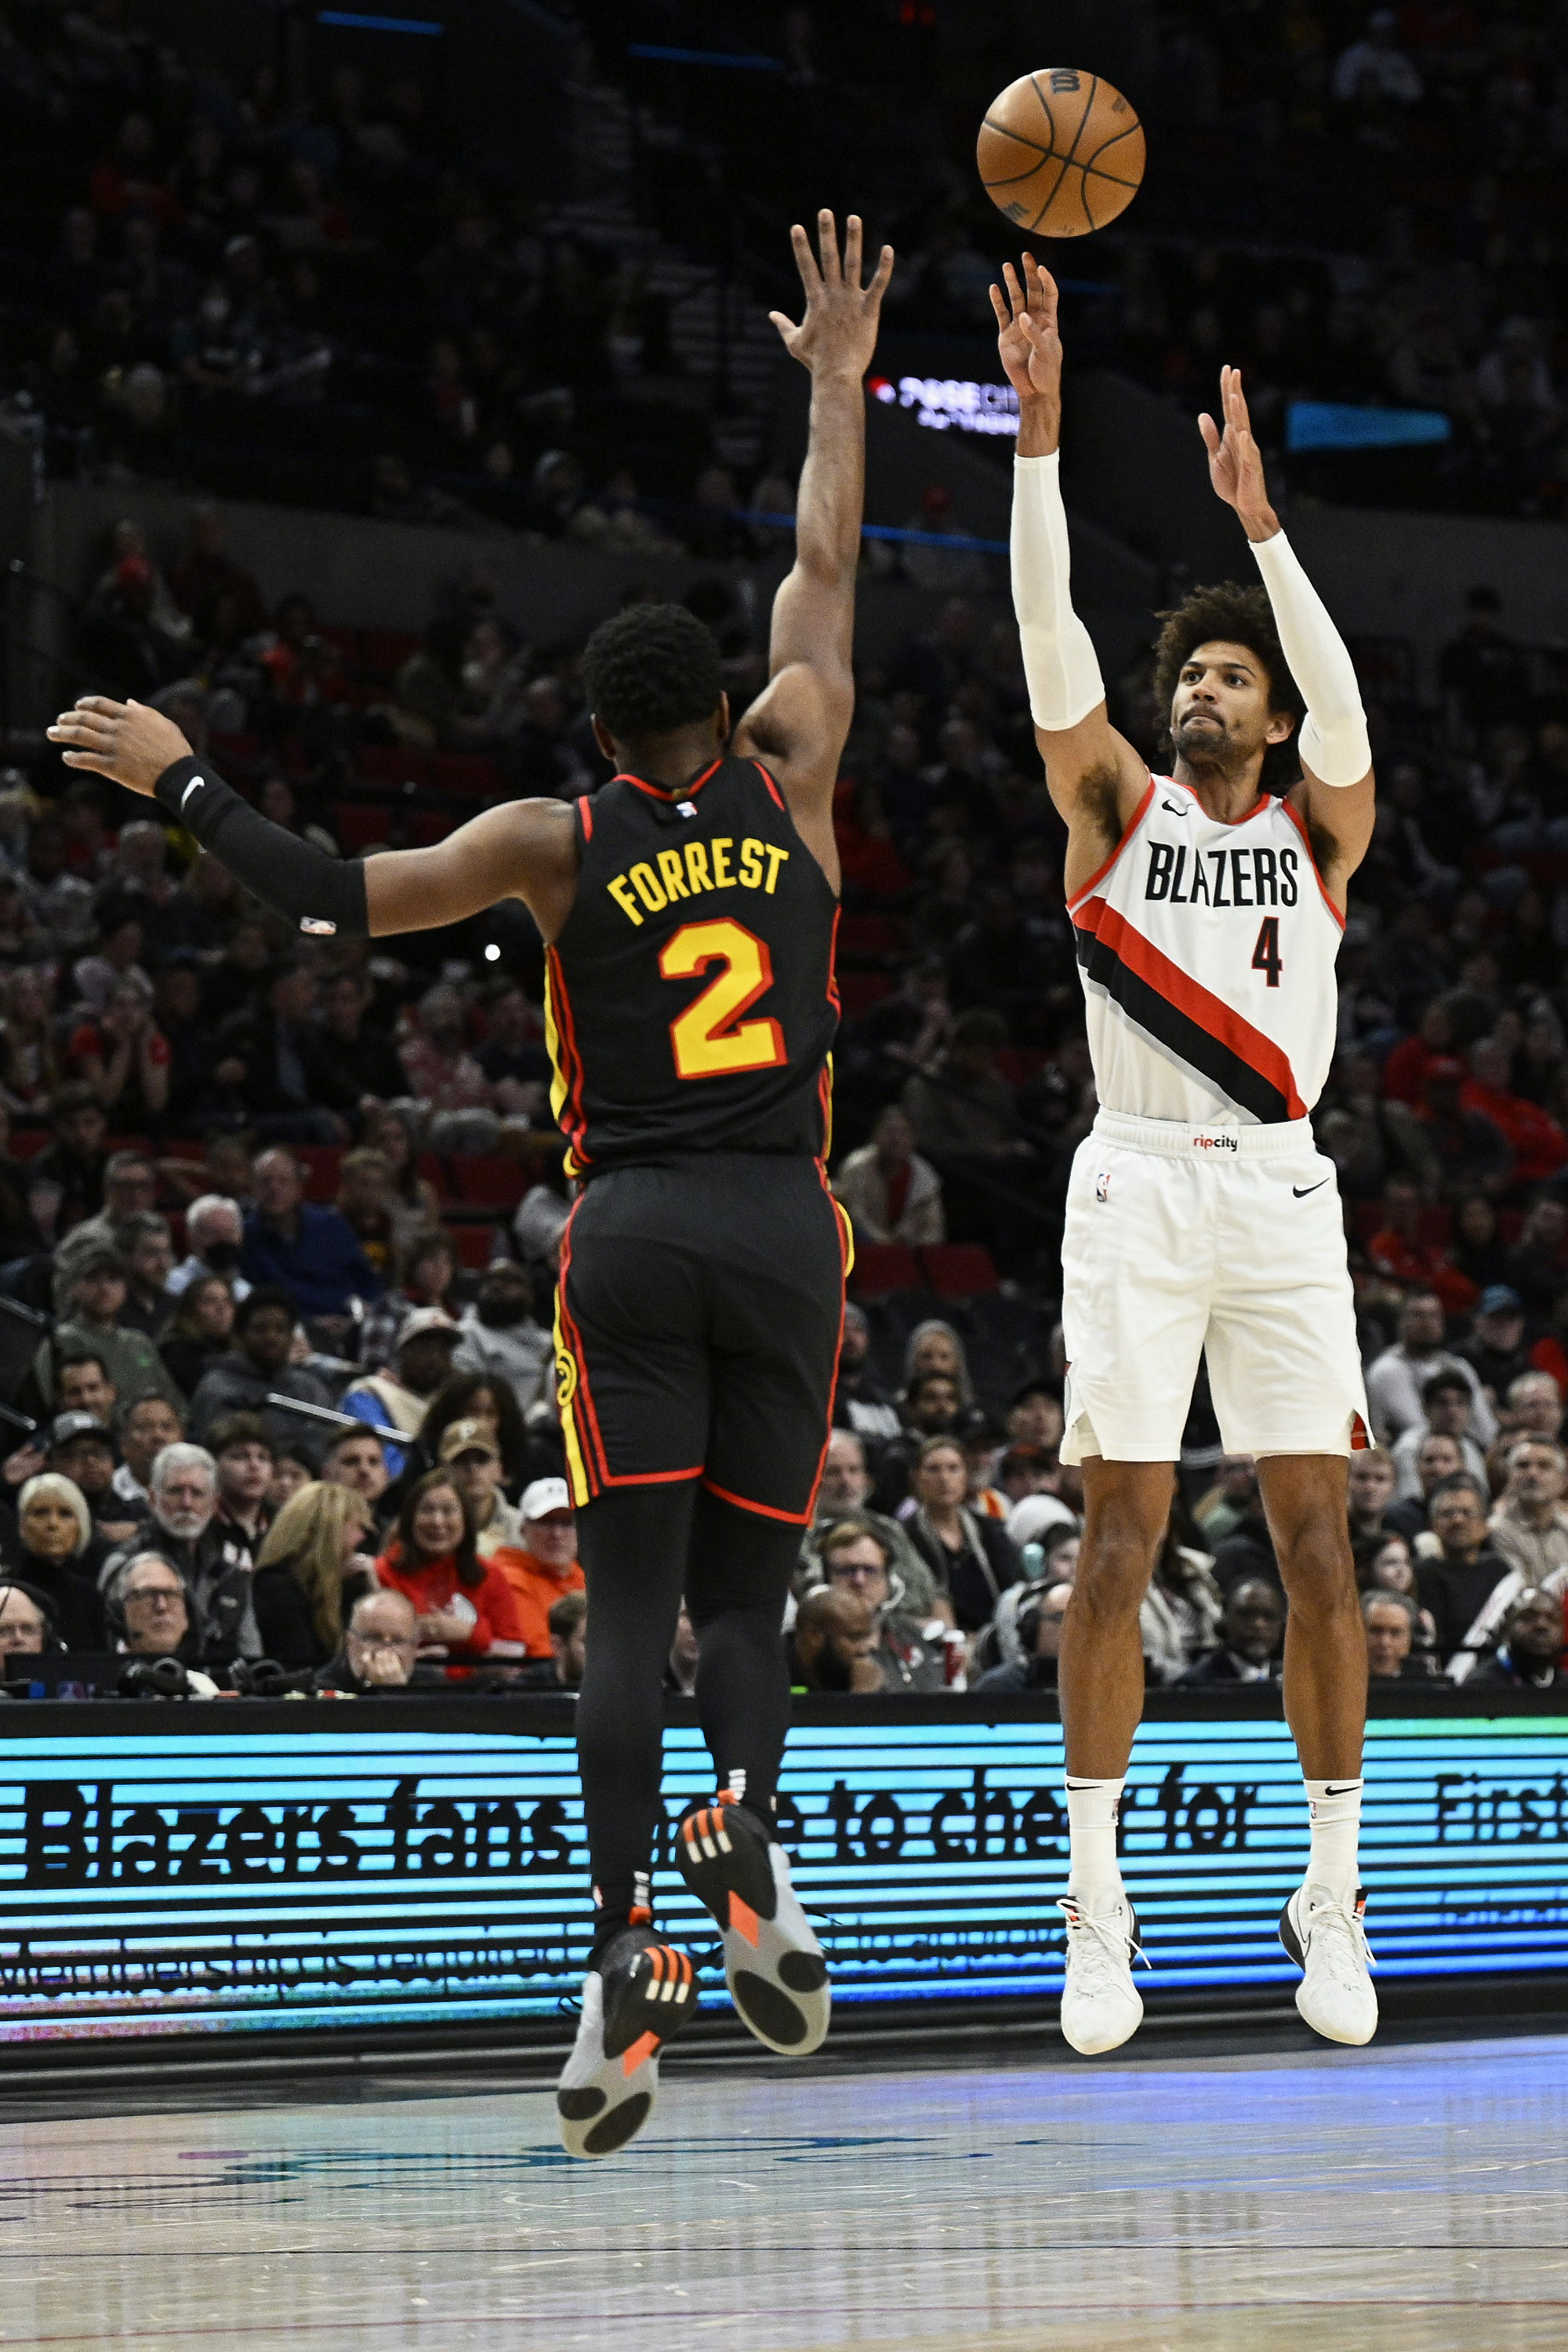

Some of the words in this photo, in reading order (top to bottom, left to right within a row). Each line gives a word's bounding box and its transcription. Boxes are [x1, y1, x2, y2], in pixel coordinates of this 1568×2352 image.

[606, 837, 789, 926] FORREST
[1145, 840, 1298, 907] BLAZERS
[1251, 916, 1283, 987] 4
[658, 916, 789, 1080] 2
[1193, 1134, 1238, 1152] ripcity
[26, 1780, 360, 1884] Blazers
